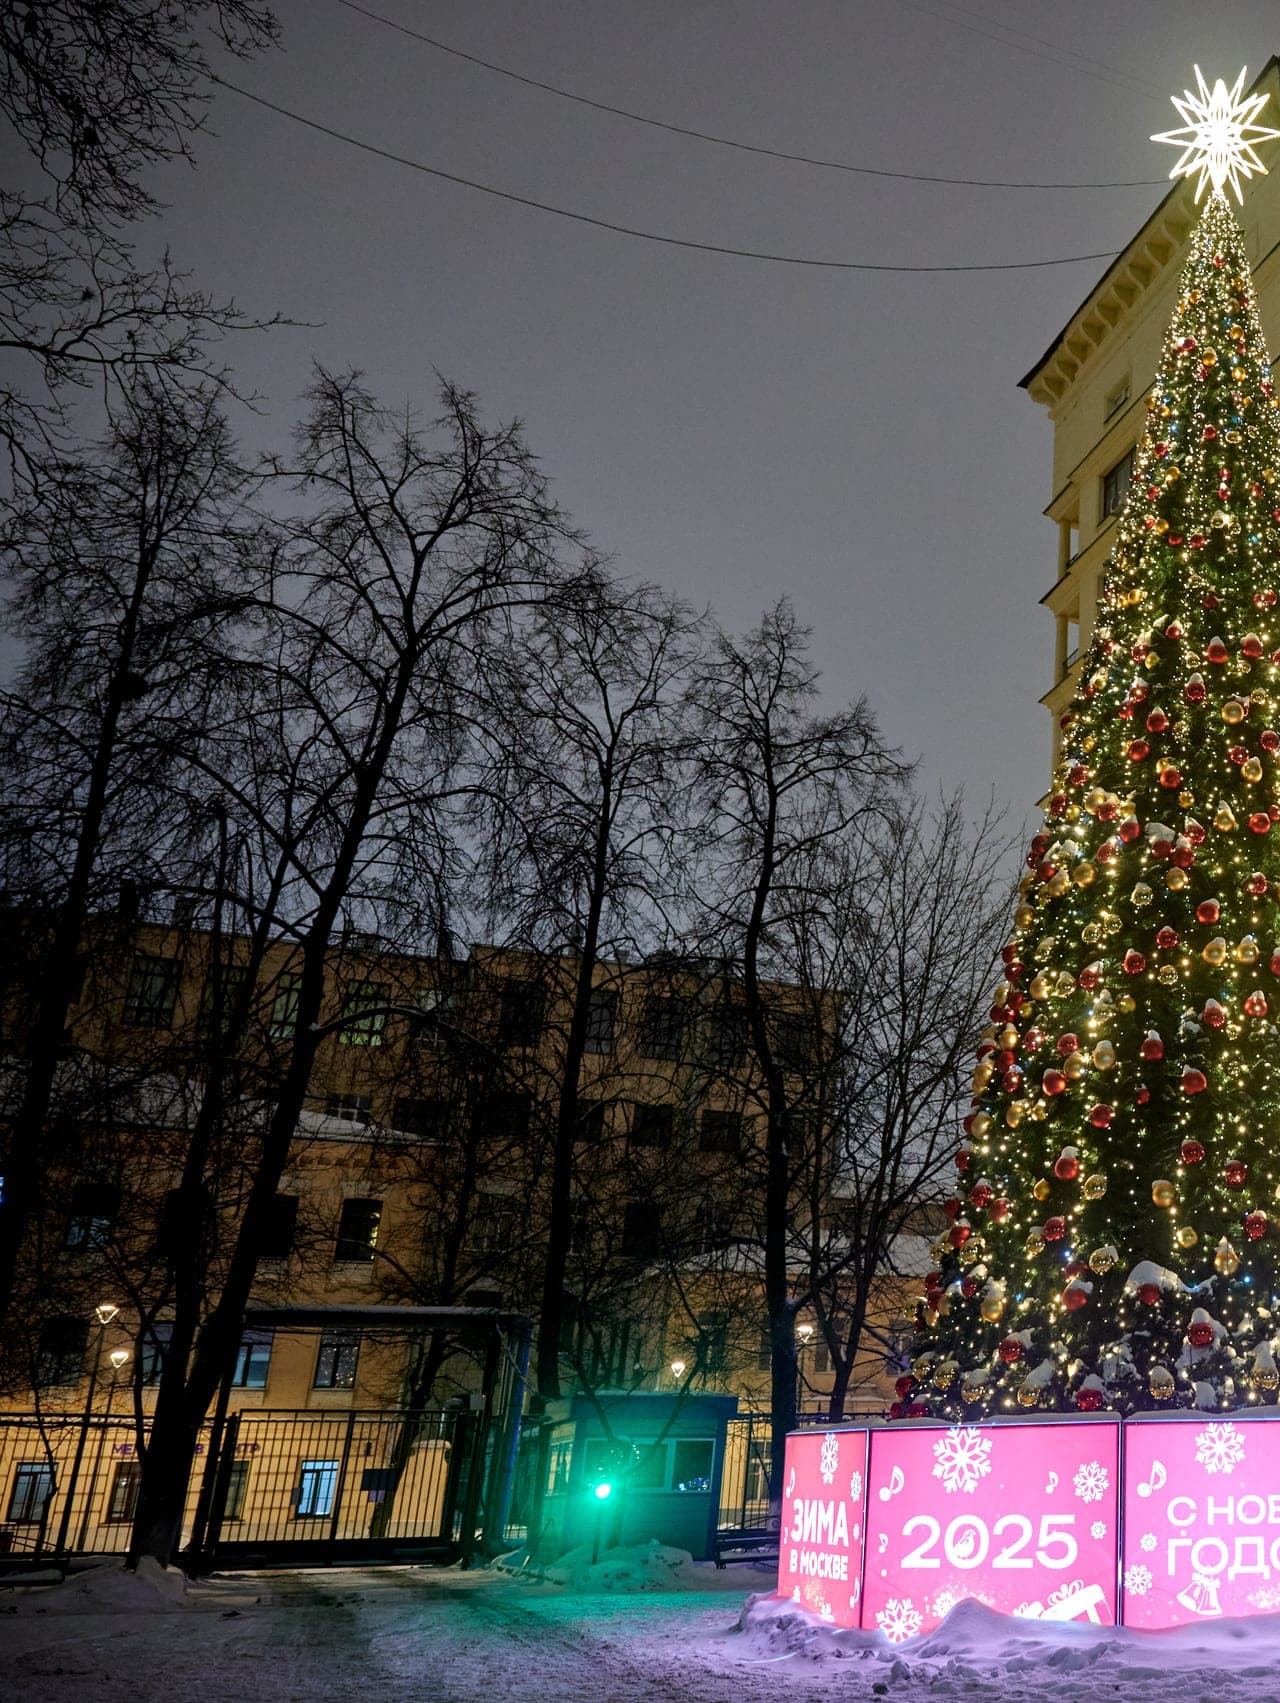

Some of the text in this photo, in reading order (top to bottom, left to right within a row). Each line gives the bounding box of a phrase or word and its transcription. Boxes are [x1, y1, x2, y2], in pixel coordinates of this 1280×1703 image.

[791, 1498, 849, 1547] ЗИМА
[1167, 1496, 1197, 1527] С
[901, 1514, 1078, 1569] 2025
[790, 1549, 848, 1581] В МОСКВЕ
